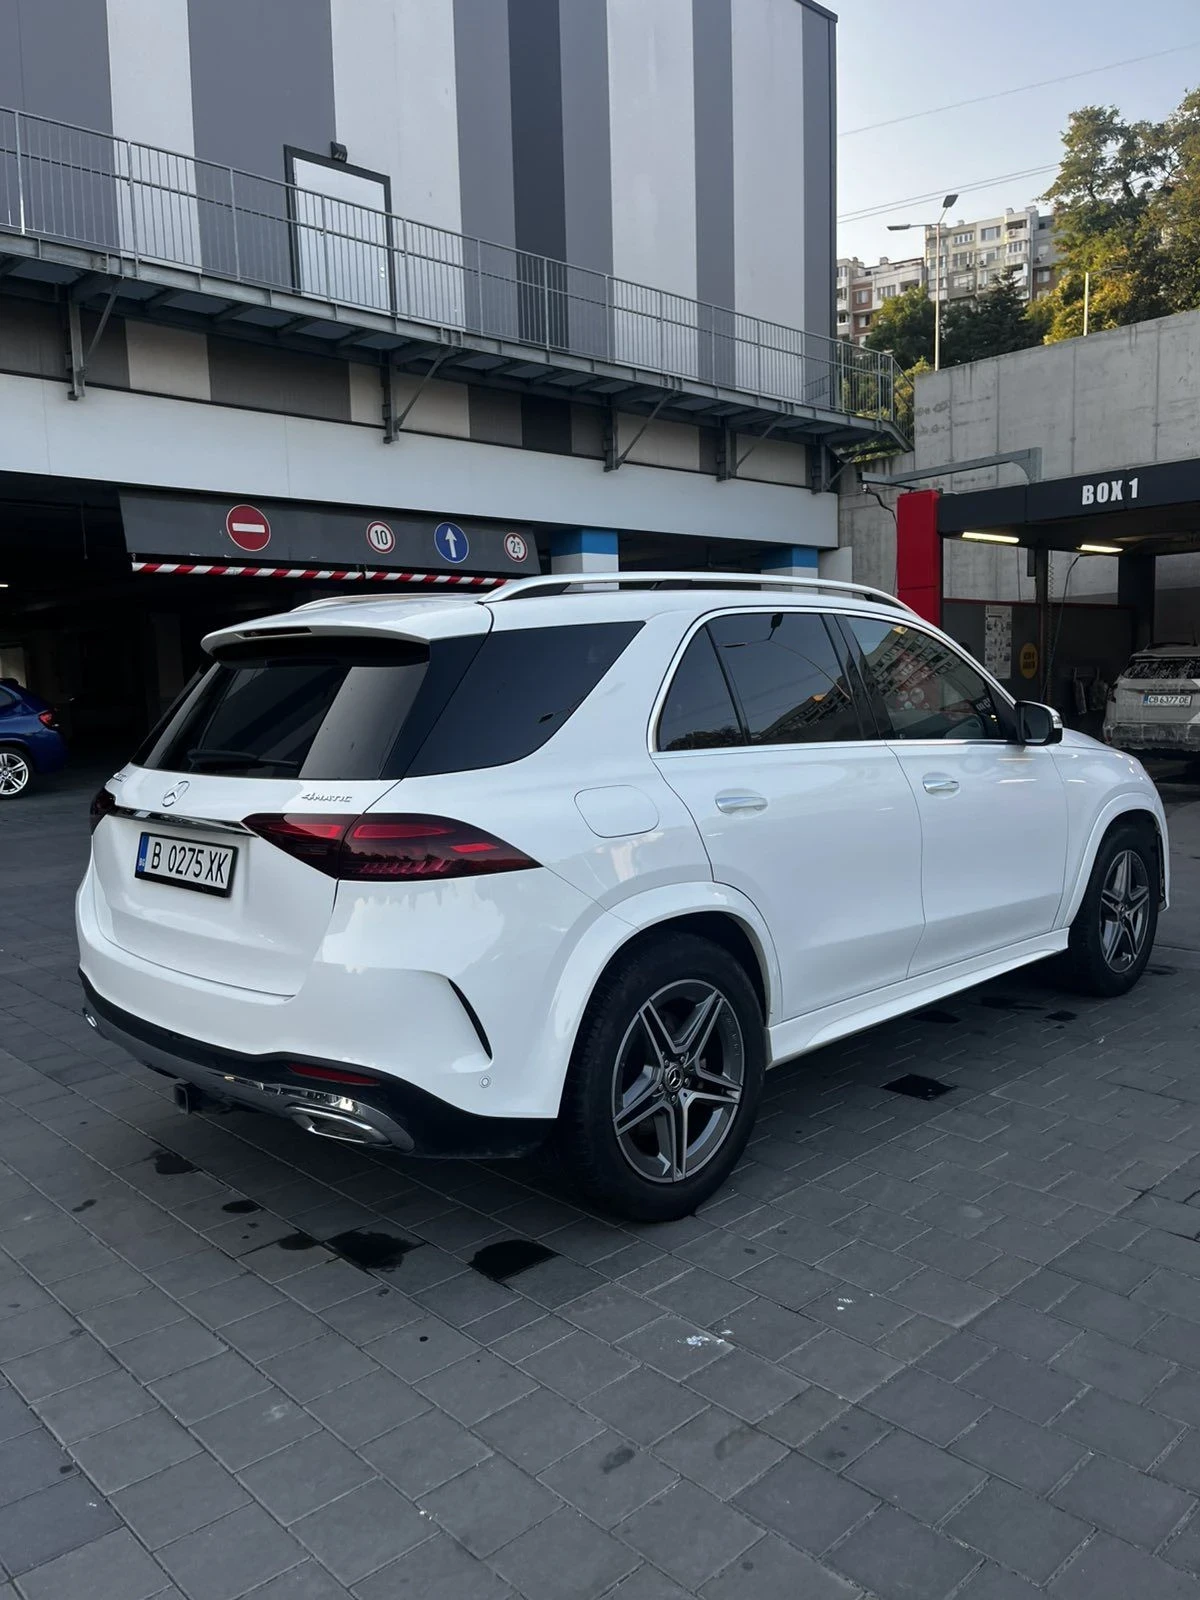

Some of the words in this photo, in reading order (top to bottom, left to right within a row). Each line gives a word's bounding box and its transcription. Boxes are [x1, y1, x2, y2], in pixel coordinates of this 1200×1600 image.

[1082, 480, 1123, 505] BOX
[1129, 478, 1138, 498] 1
[375, 530, 388, 545] 10
[301, 792, 352, 803] 4MATIC
[151, 842, 162, 869] B
[168, 845, 204, 878] 0275
[205, 850, 229, 884] XK
